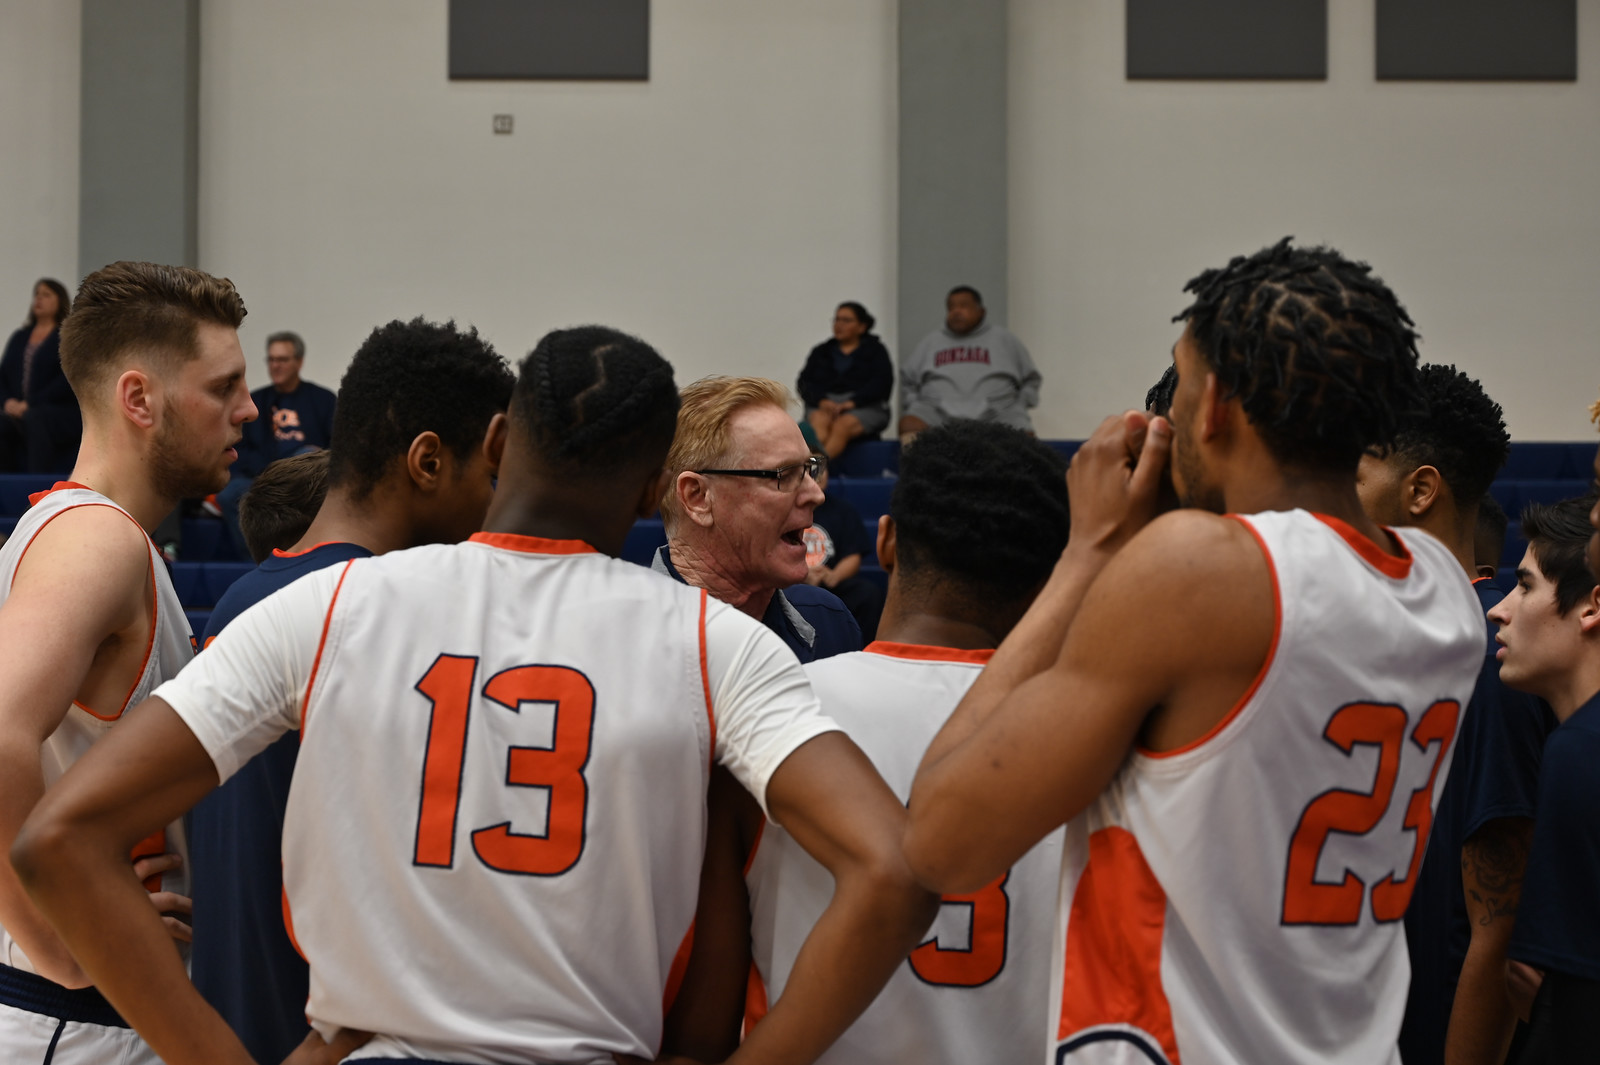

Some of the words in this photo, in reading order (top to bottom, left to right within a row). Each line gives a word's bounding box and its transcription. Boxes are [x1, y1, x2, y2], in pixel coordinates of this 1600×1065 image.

[934, 345, 992, 368] GONZAGA
[412, 652, 596, 877] 13
[1280, 698, 1460, 926] 23
